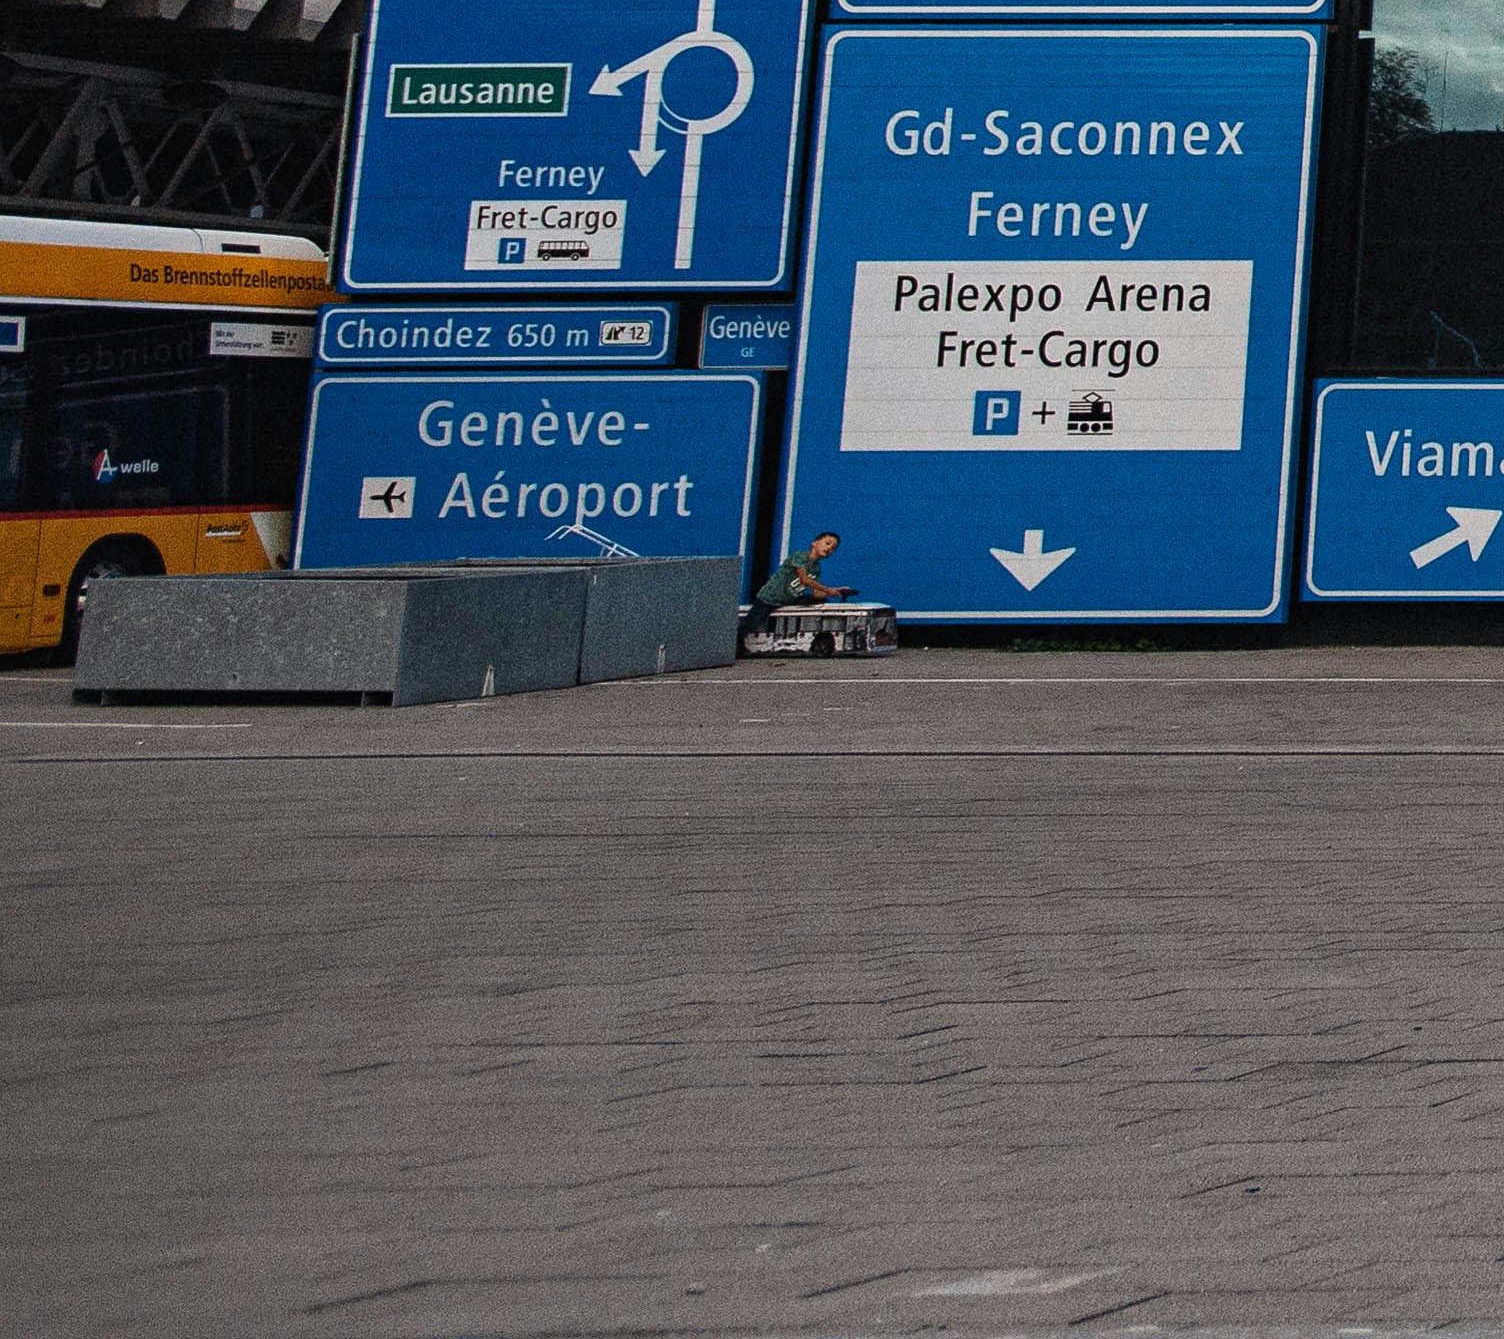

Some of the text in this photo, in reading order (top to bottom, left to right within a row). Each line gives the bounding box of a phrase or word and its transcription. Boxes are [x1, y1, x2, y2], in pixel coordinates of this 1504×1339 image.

[402, 76, 555, 105] Lausanne
[885, 107, 1244, 156] Gd-Saconnex
[129, 263, 159, 285] Das
[894, 272, 1211, 323] Palexpo Arena
[336, 318, 645, 349] Choindez 650 m 12
[709, 315, 791, 340] Genève
[439, 470, 693, 527] Aéroport
